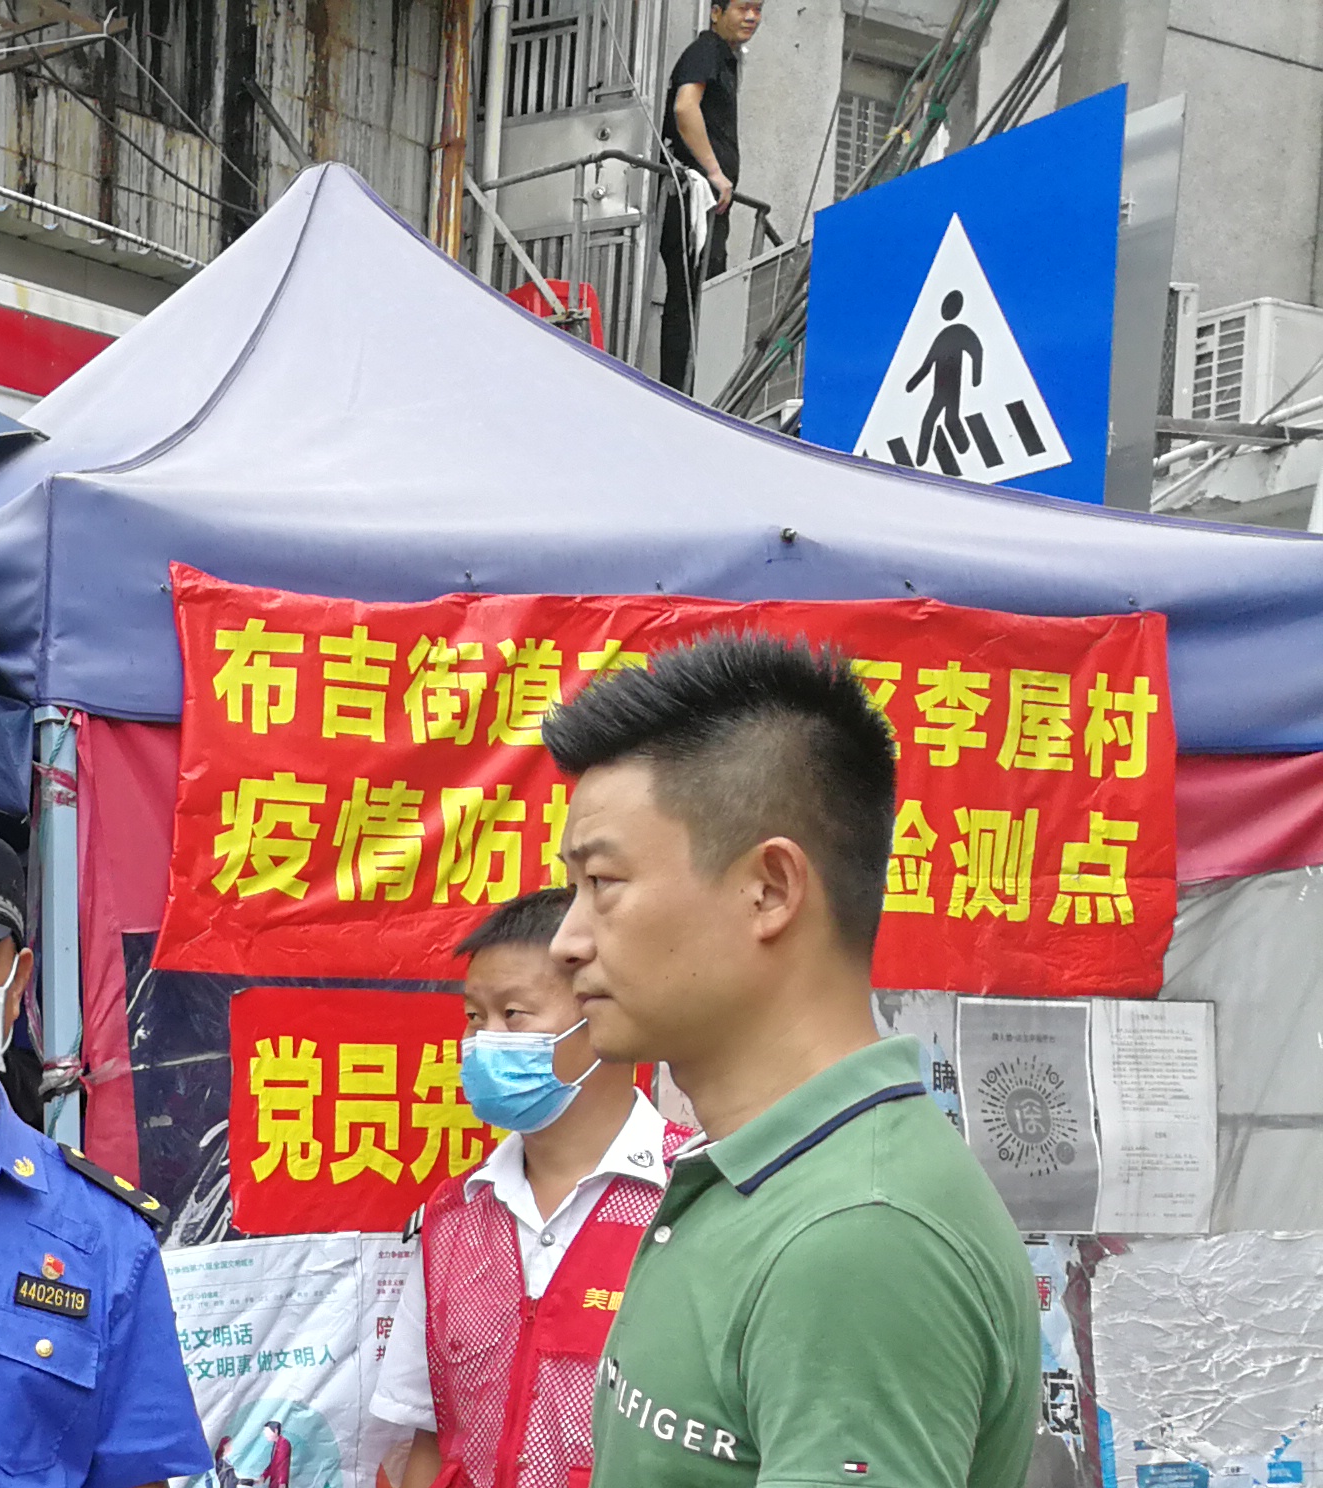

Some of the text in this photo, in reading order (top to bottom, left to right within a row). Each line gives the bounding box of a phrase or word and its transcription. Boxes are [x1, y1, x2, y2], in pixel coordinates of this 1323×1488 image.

[250, 1035, 513, 1185] 党员先
[20, 1281, 85, 1310] 44026119
[257, 1344, 337, 1374] 做文明人
